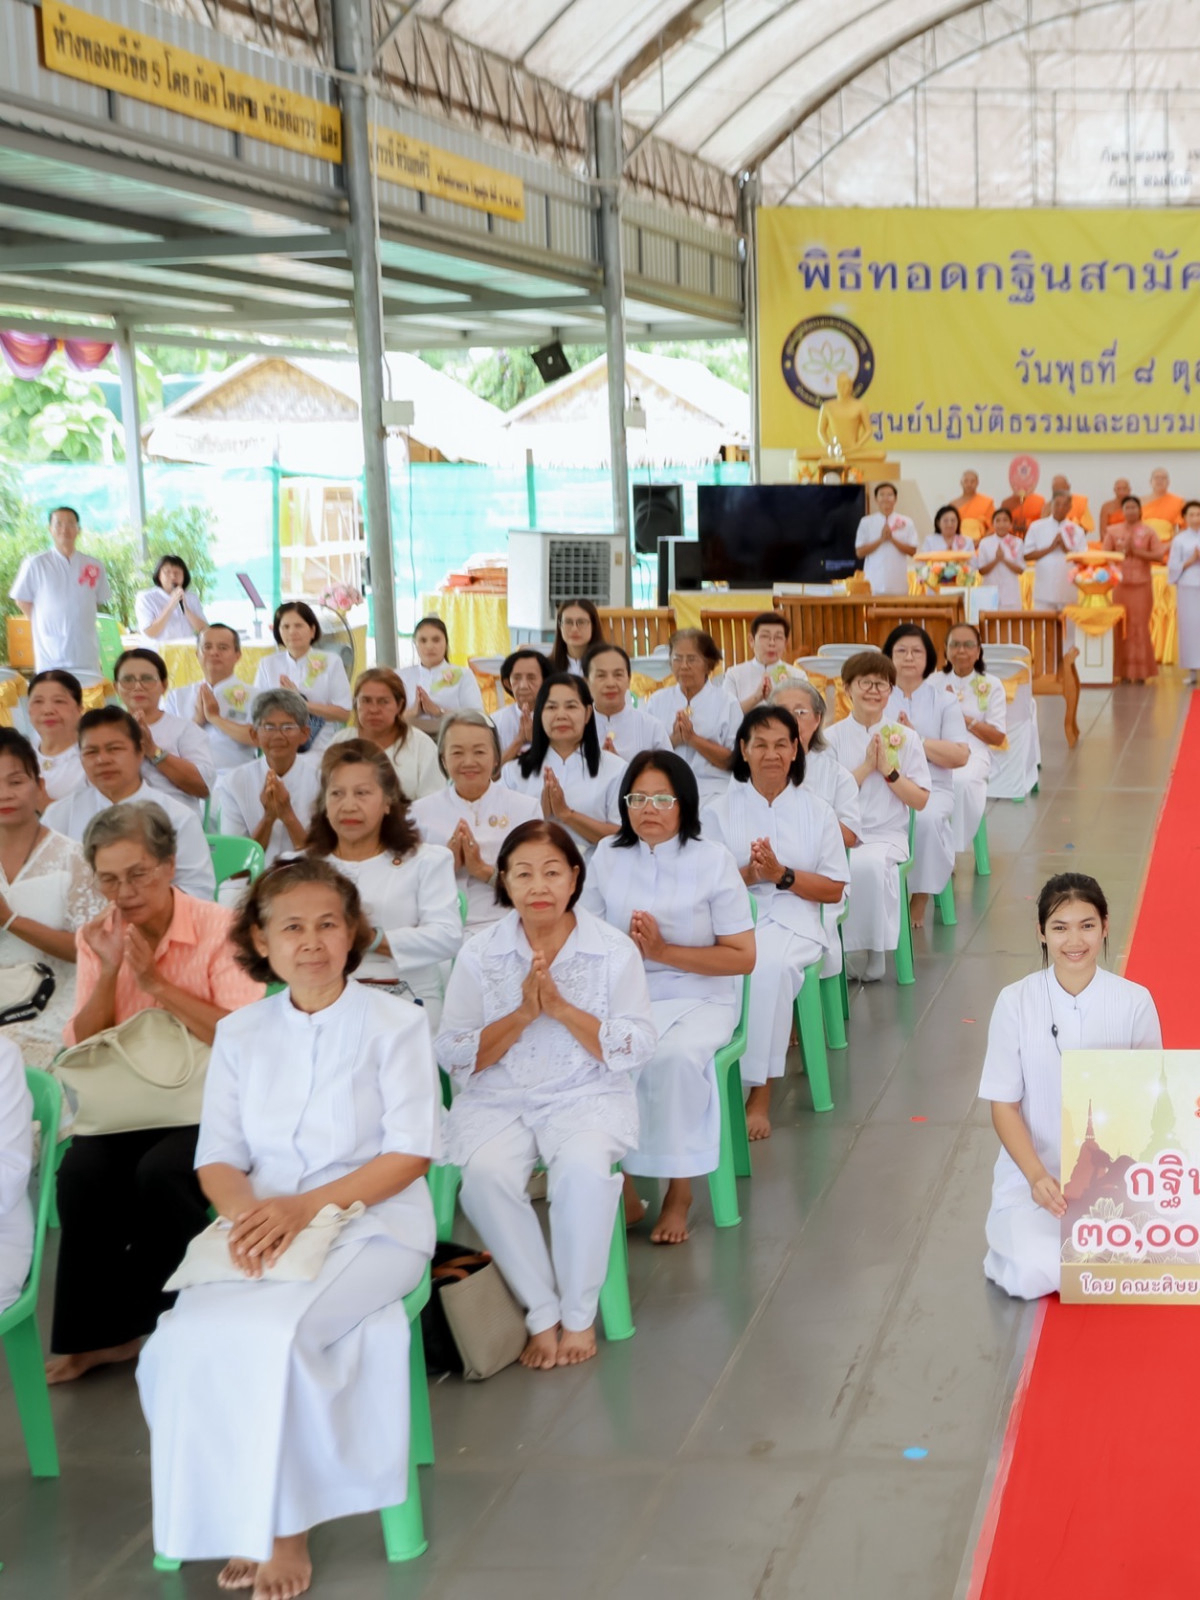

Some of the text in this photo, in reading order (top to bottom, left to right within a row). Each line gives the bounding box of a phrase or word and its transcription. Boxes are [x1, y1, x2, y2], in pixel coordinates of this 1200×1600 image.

[1015, 339, 1119, 396] วันพุธที่
[1133, 357, 1156, 385] ๘
[1081, 1273, 1115, 1293] โดย
